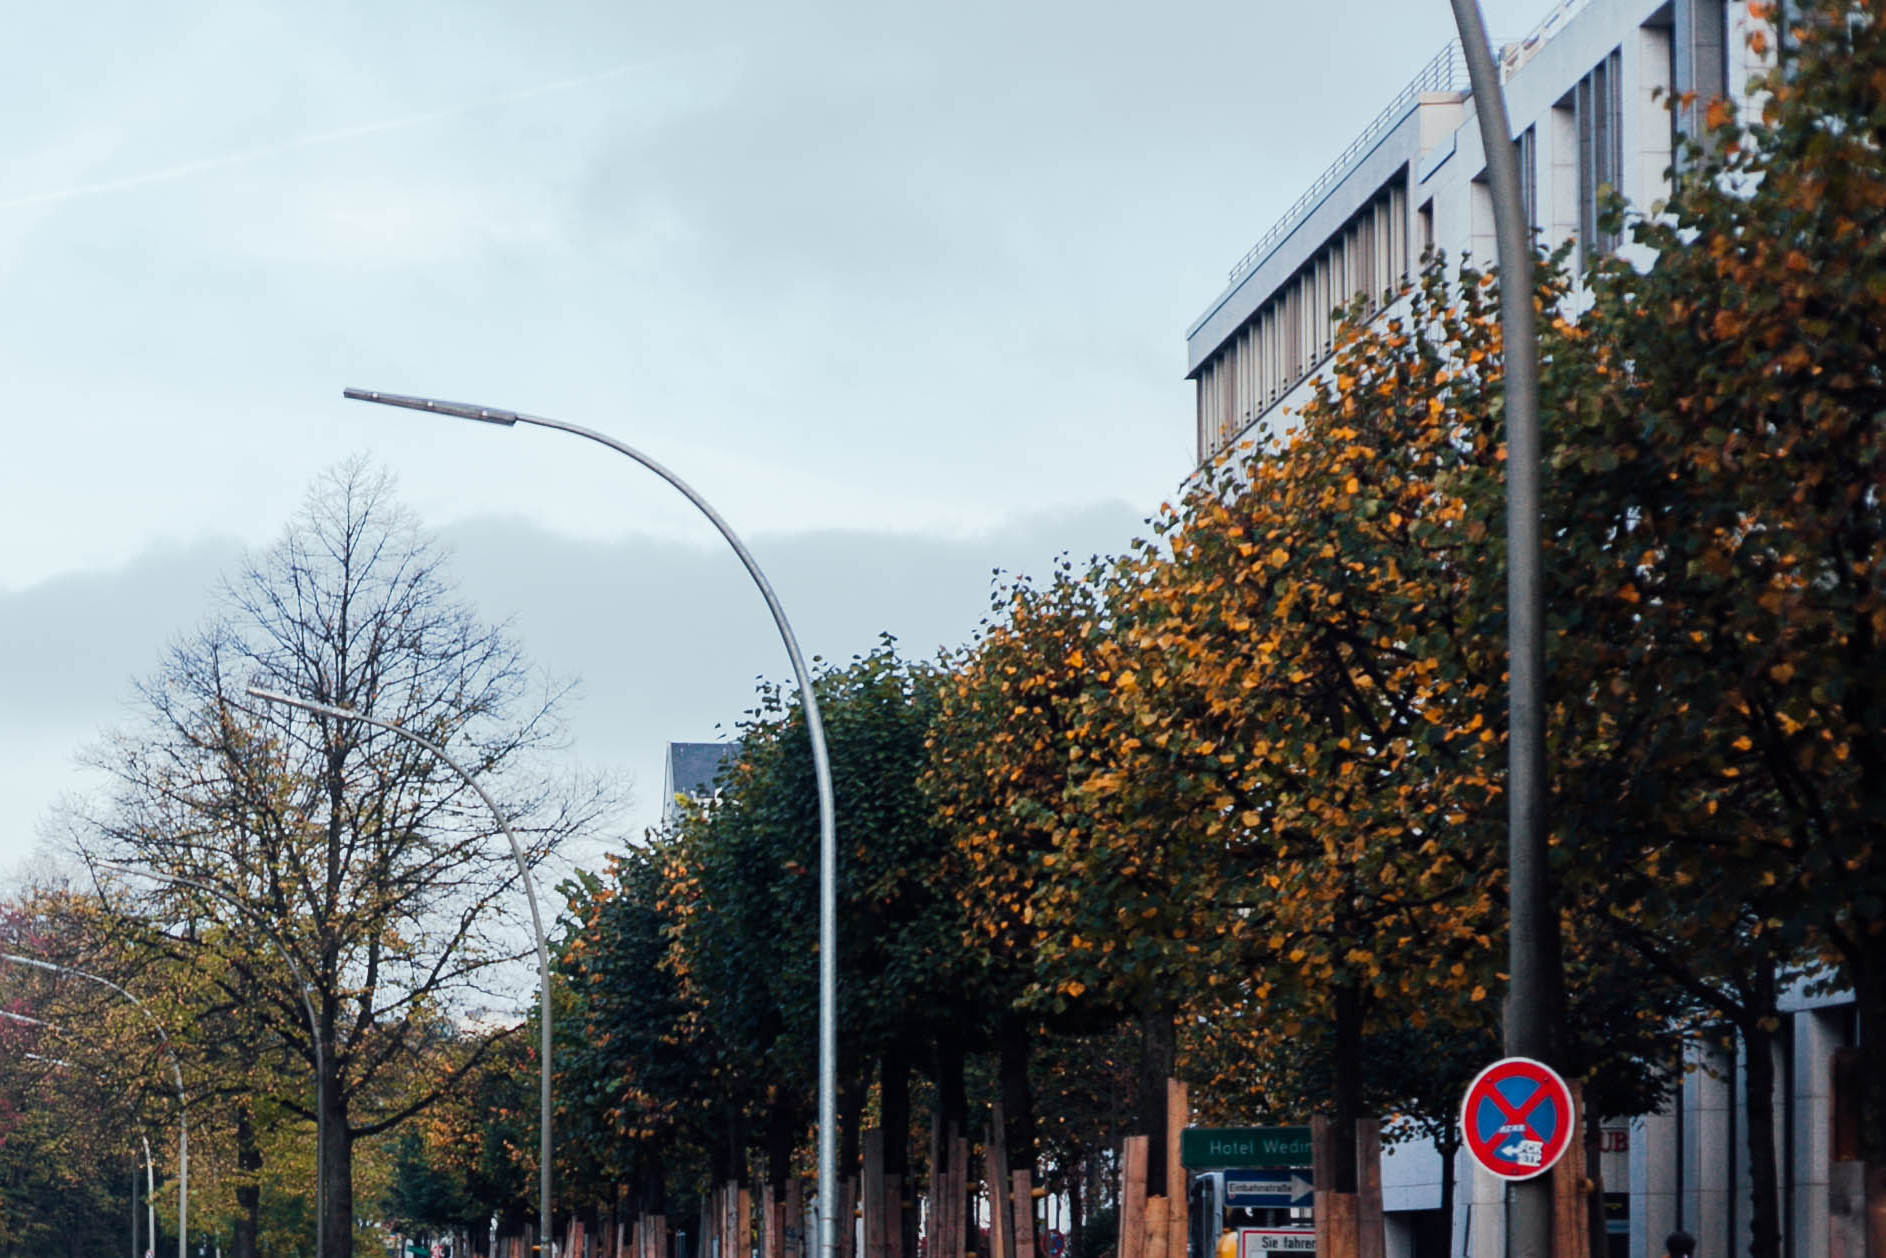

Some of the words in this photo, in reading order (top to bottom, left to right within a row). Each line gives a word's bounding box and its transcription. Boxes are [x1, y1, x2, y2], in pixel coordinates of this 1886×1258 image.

[1210, 1140, 1254, 1155] Hotel
[1229, 1183, 1292, 1193] Einbahnstraße
[1262, 1236, 1278, 1248] Sie
